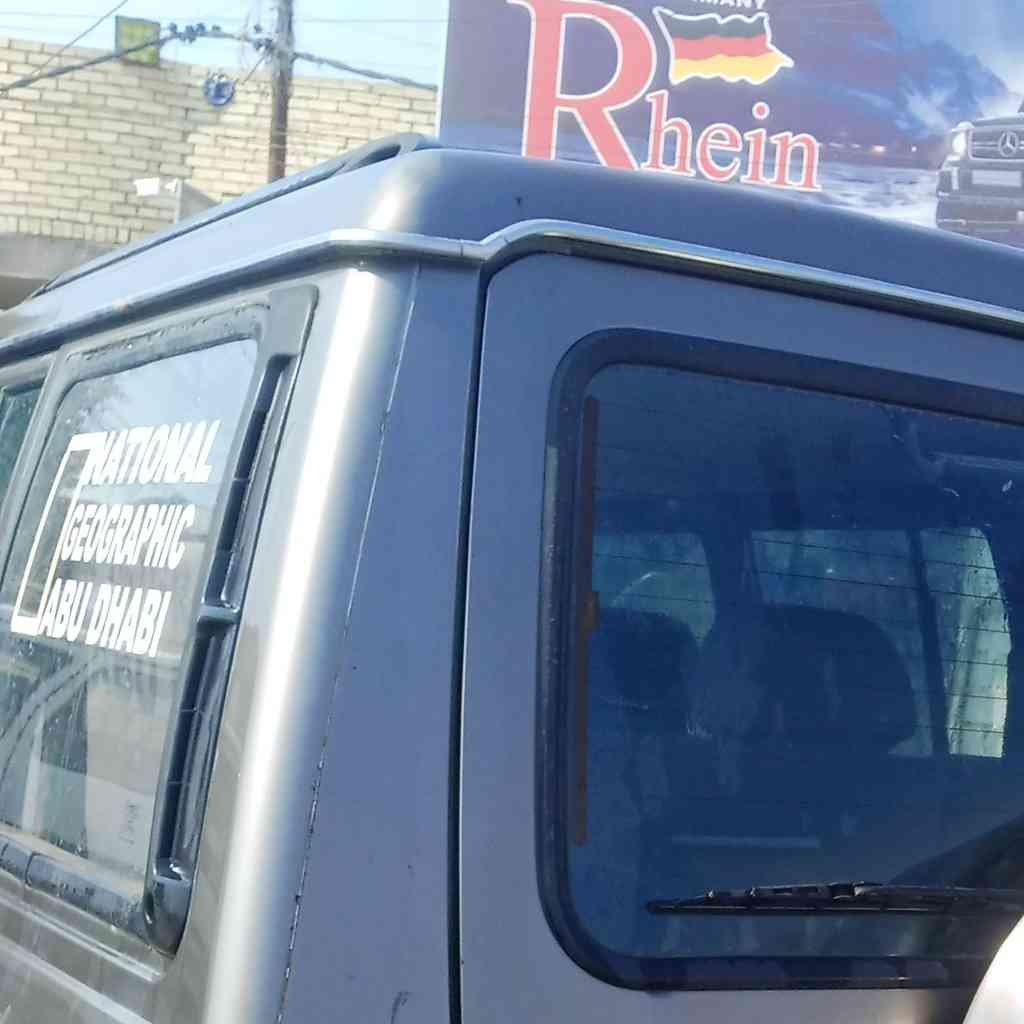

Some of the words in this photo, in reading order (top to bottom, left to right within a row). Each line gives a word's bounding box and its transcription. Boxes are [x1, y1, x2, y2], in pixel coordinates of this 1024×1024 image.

[505, 0, 823, 192] Rhein
[82, 419, 222, 485] NATIONAL
[61, 503, 197, 570] GEOGRAPHIC
[38, 577, 93, 642] ABU
[84, 583, 173, 658] DHABI
